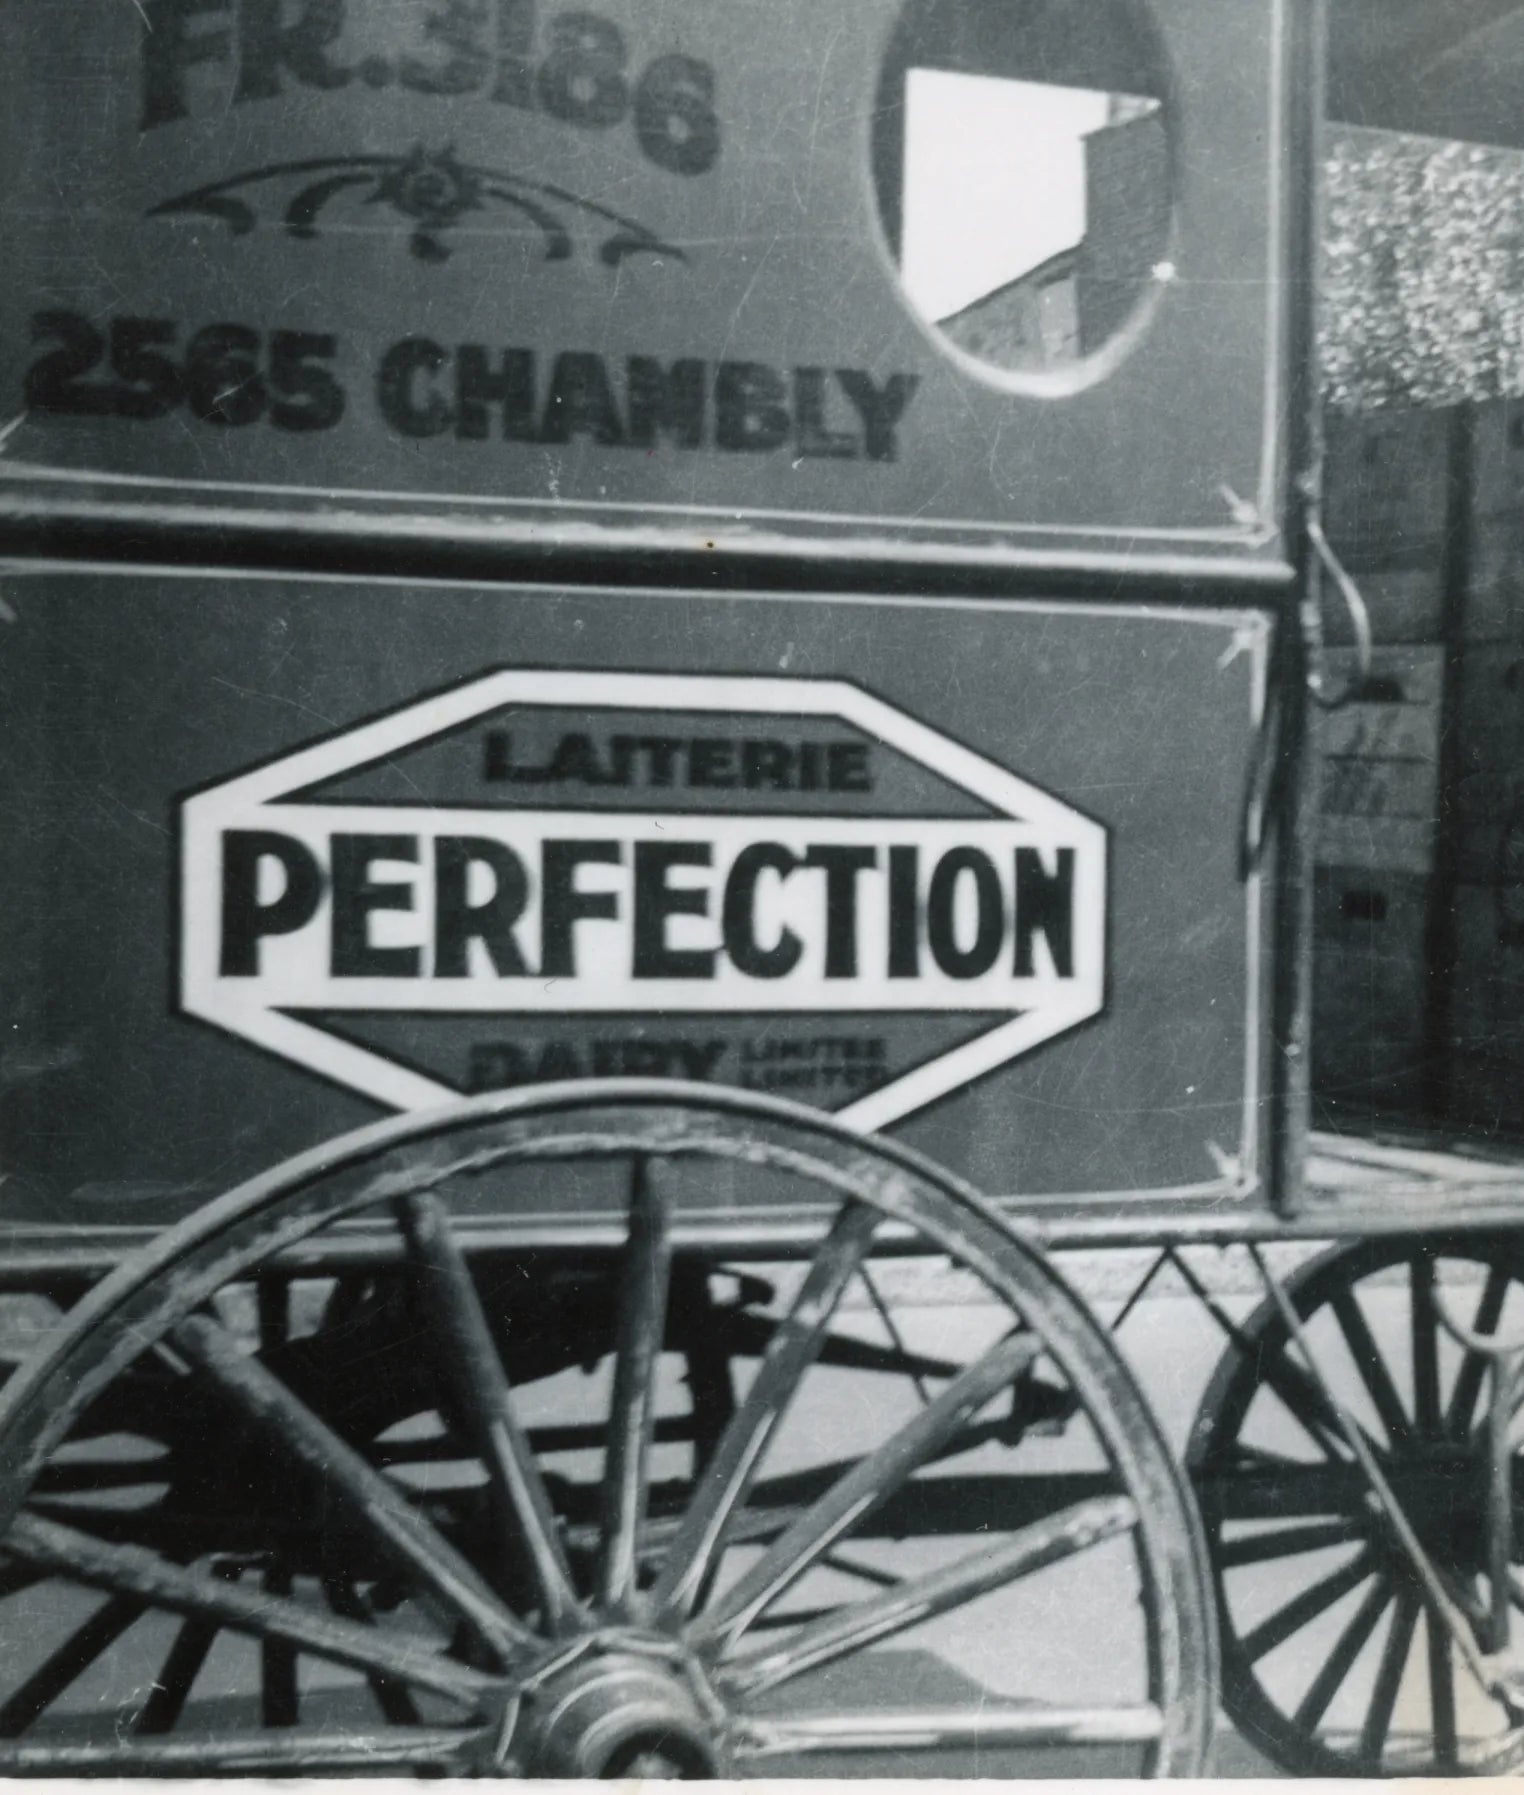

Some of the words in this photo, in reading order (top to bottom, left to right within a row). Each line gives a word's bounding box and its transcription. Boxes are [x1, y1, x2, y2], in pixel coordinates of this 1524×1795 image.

[25, 310, 345, 432] 2565
[375, 336, 921, 463] CHAMBLY
[483, 729, 873, 792] LAITERIE
[216, 828, 1077, 981] PERFECTION
